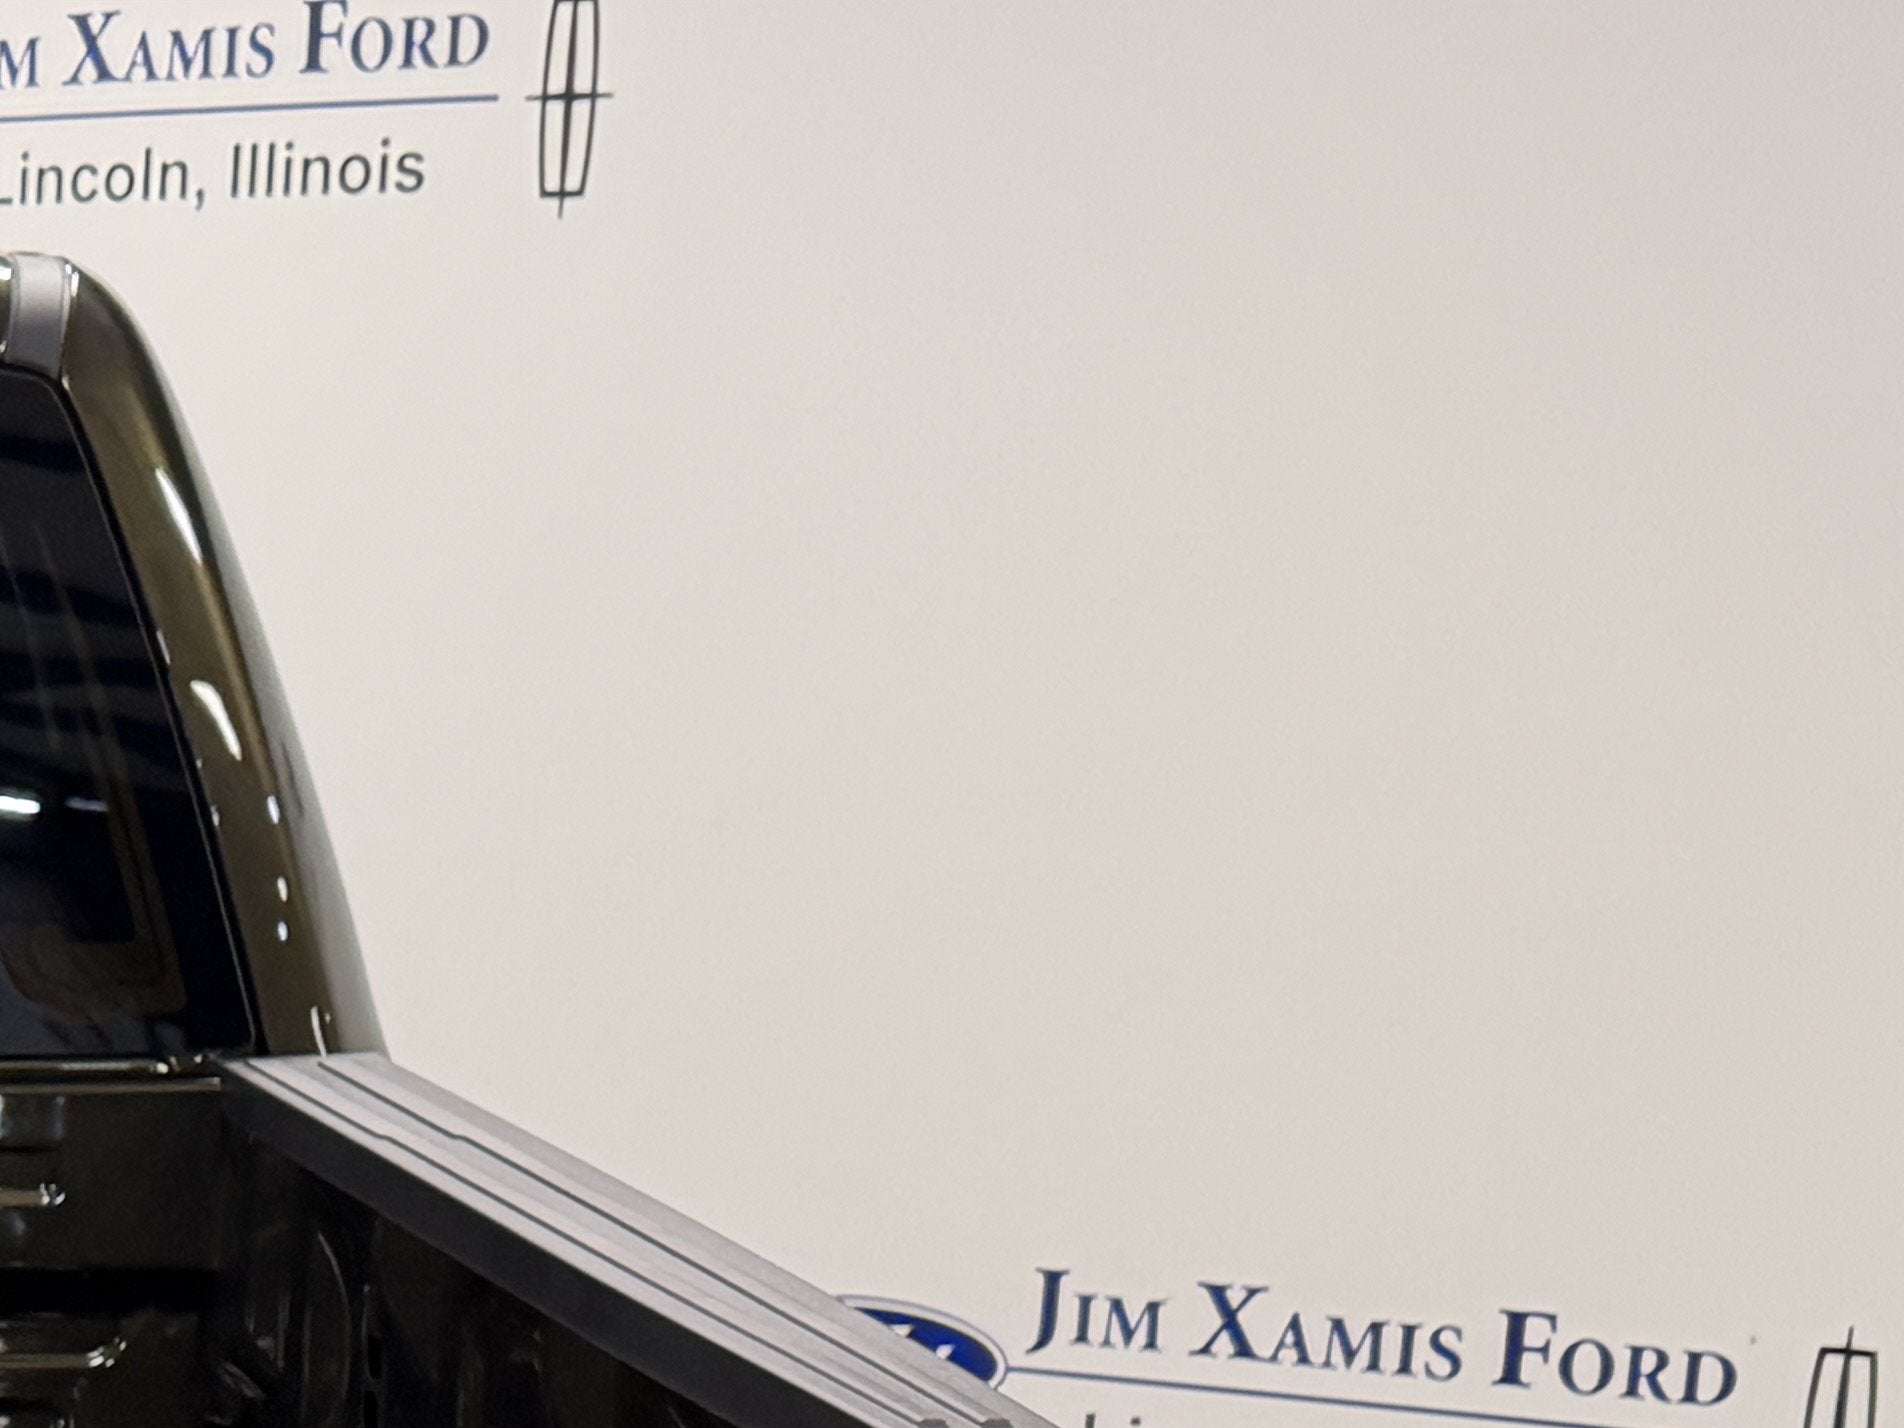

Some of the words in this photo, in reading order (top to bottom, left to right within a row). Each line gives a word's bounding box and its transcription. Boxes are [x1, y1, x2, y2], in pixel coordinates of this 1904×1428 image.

[62, 9, 275, 86] XAMIS
[299, 0, 489, 74] FORD
[229, 139, 425, 200] Illinois
[1026, 1266, 1169, 1356] JIM
[1189, 1279, 1465, 1383] XAMIS
[1492, 1306, 1739, 1408] FORD
